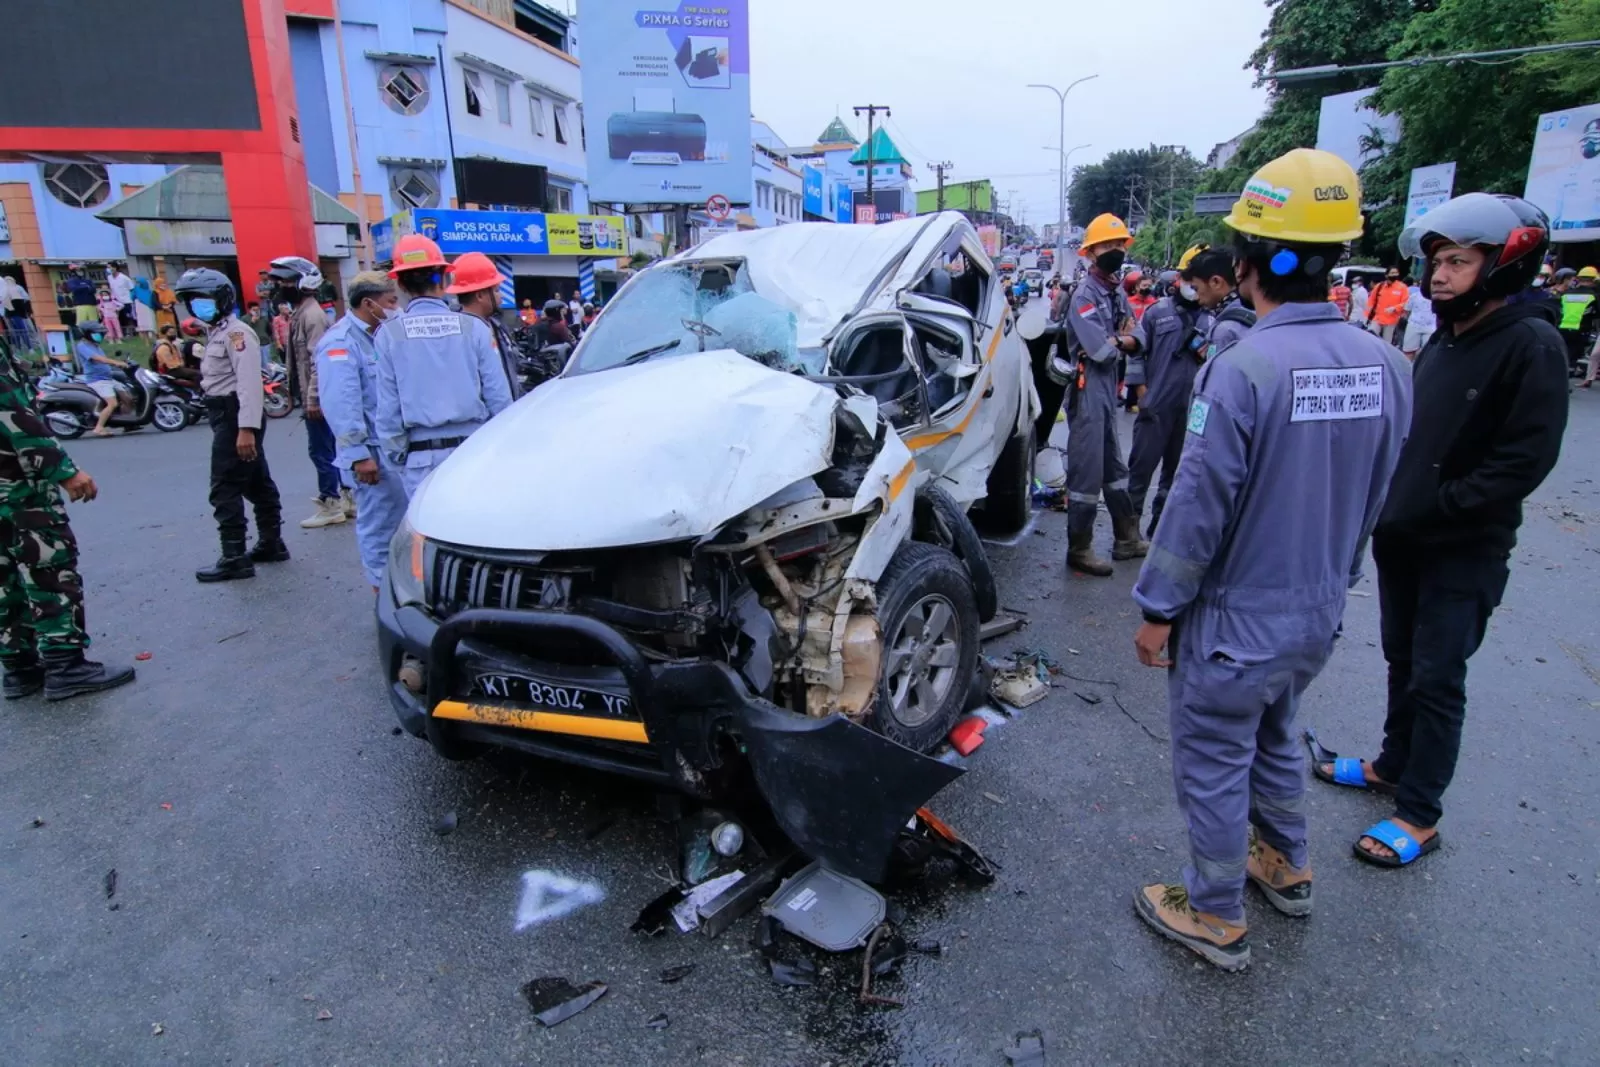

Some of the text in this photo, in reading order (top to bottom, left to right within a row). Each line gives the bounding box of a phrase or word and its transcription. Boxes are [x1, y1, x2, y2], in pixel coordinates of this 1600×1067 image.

[643, 13, 729, 28] PIXMA G Series
[806, 183, 821, 199] vivo
[454, 221, 511, 233] POS POLISI
[442, 231, 524, 243] SIMPANG RAPAK
[483, 675, 509, 697] KT
[529, 681, 584, 710] 8304
